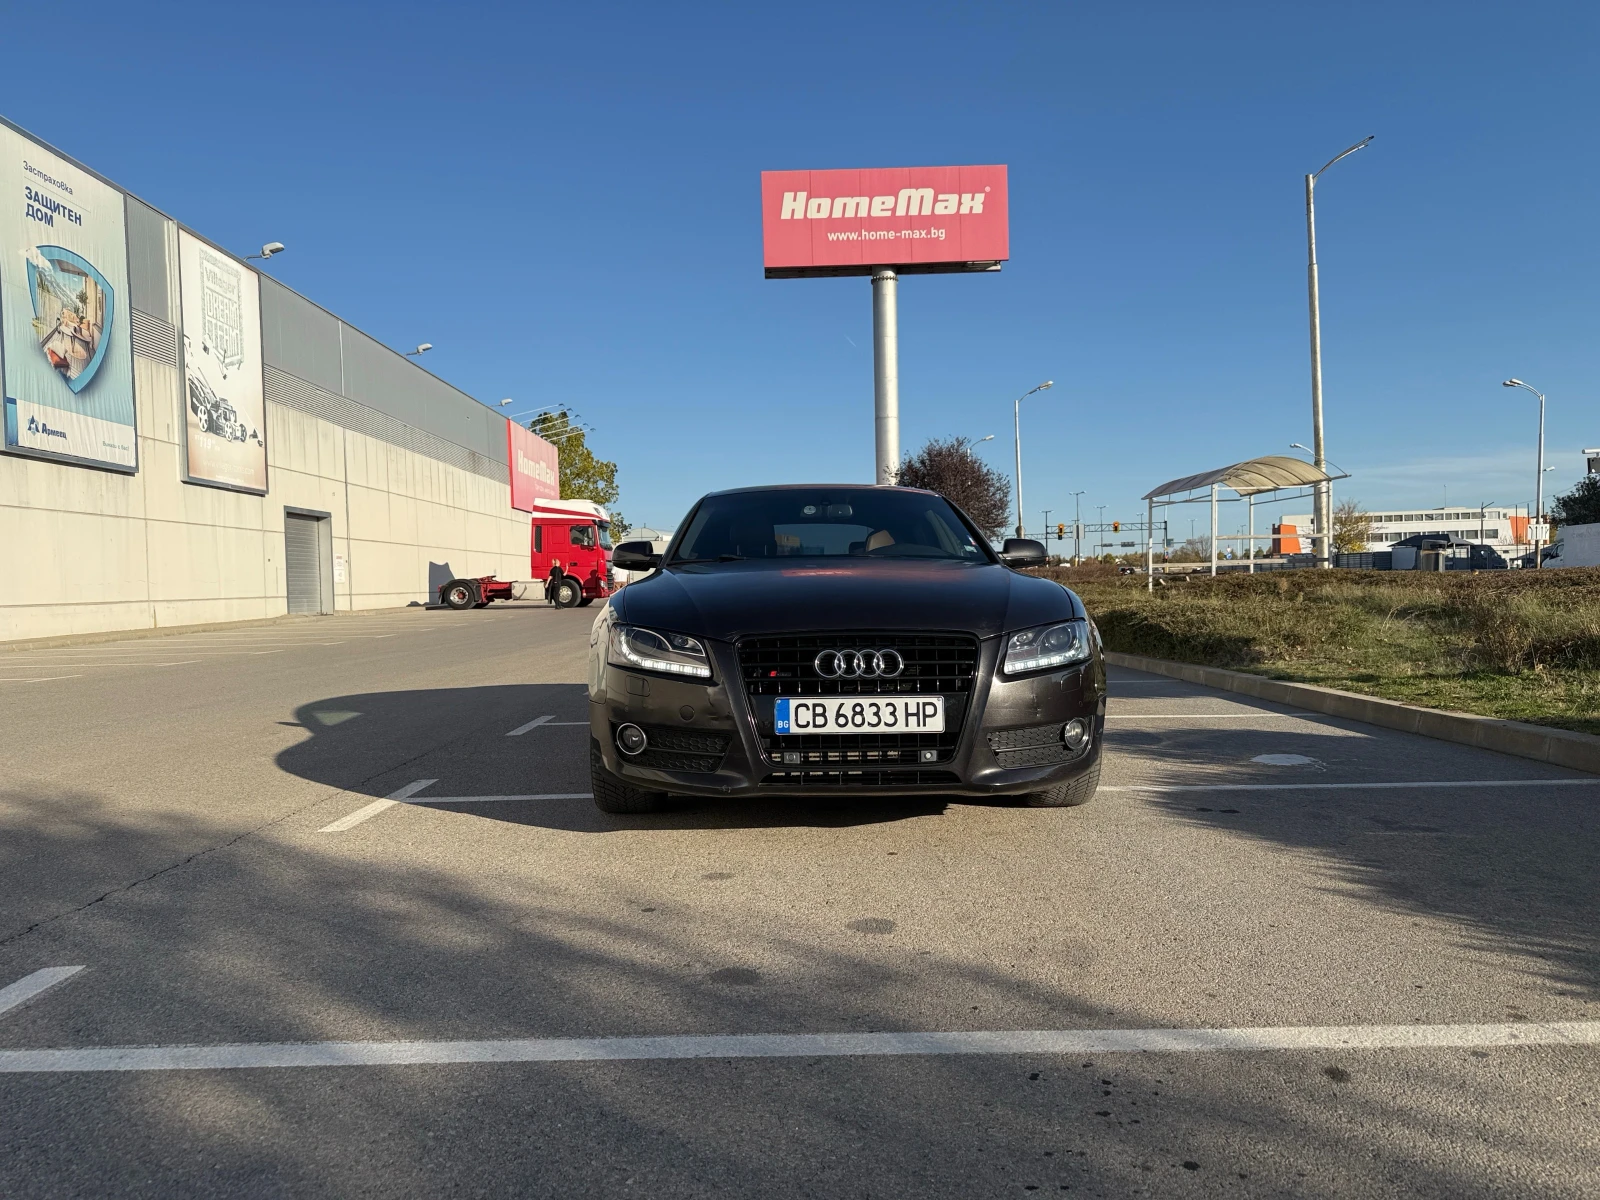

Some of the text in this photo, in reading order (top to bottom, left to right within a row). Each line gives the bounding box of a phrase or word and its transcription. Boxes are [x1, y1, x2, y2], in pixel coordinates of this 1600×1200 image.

[23, 160, 73, 195] Застраховка
[25, 185, 82, 227] ЗАЩИТЕН
[25, 203, 54, 228] ДОМ
[780, 187, 986, 220] HomeMax
[827, 227, 946, 242] www.home-max.bg
[41, 422, 67, 440] Армеец
[518, 449, 555, 486] HomeMax
[777, 720, 789, 729] BG
[794, 701, 938, 729] CB 6833 HP
